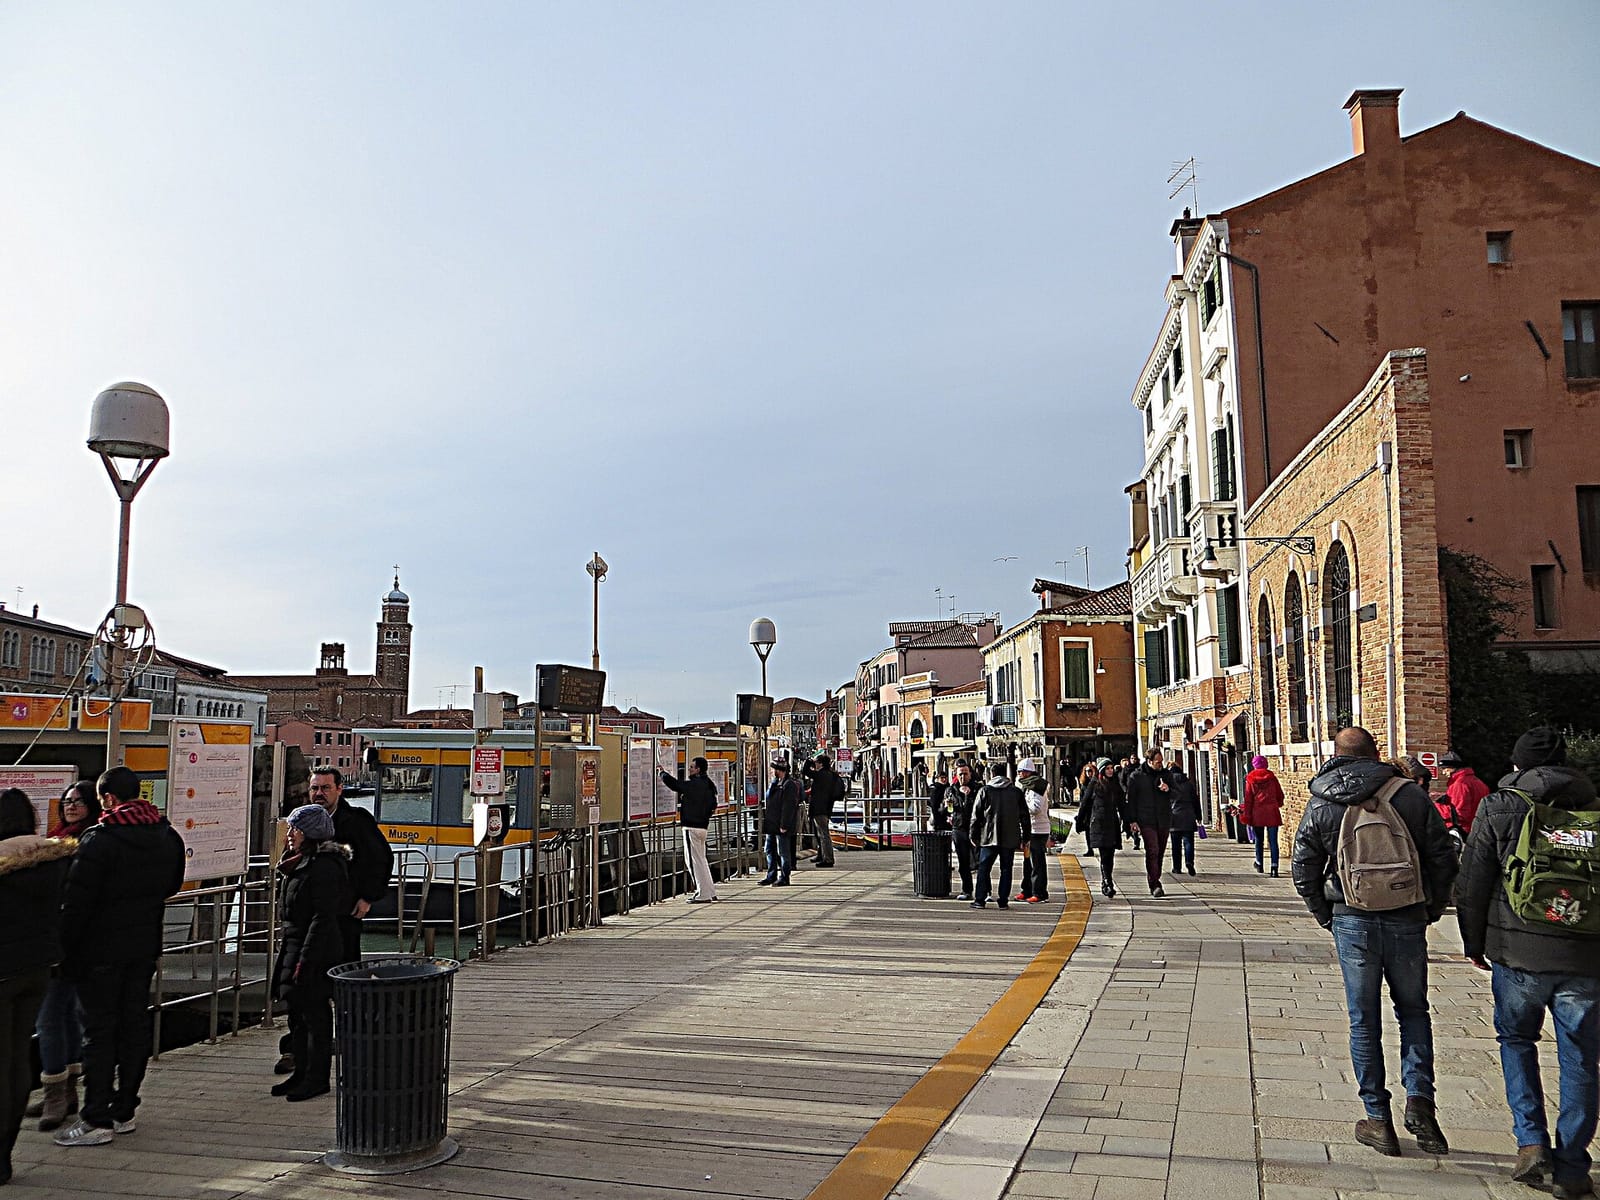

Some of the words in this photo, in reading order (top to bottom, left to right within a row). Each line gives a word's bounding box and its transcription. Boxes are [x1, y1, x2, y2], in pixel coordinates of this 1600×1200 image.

[12, 706, 27, 716] 4.1
[392, 754, 422, 763] Museo
[389, 829, 419, 839] Museo
